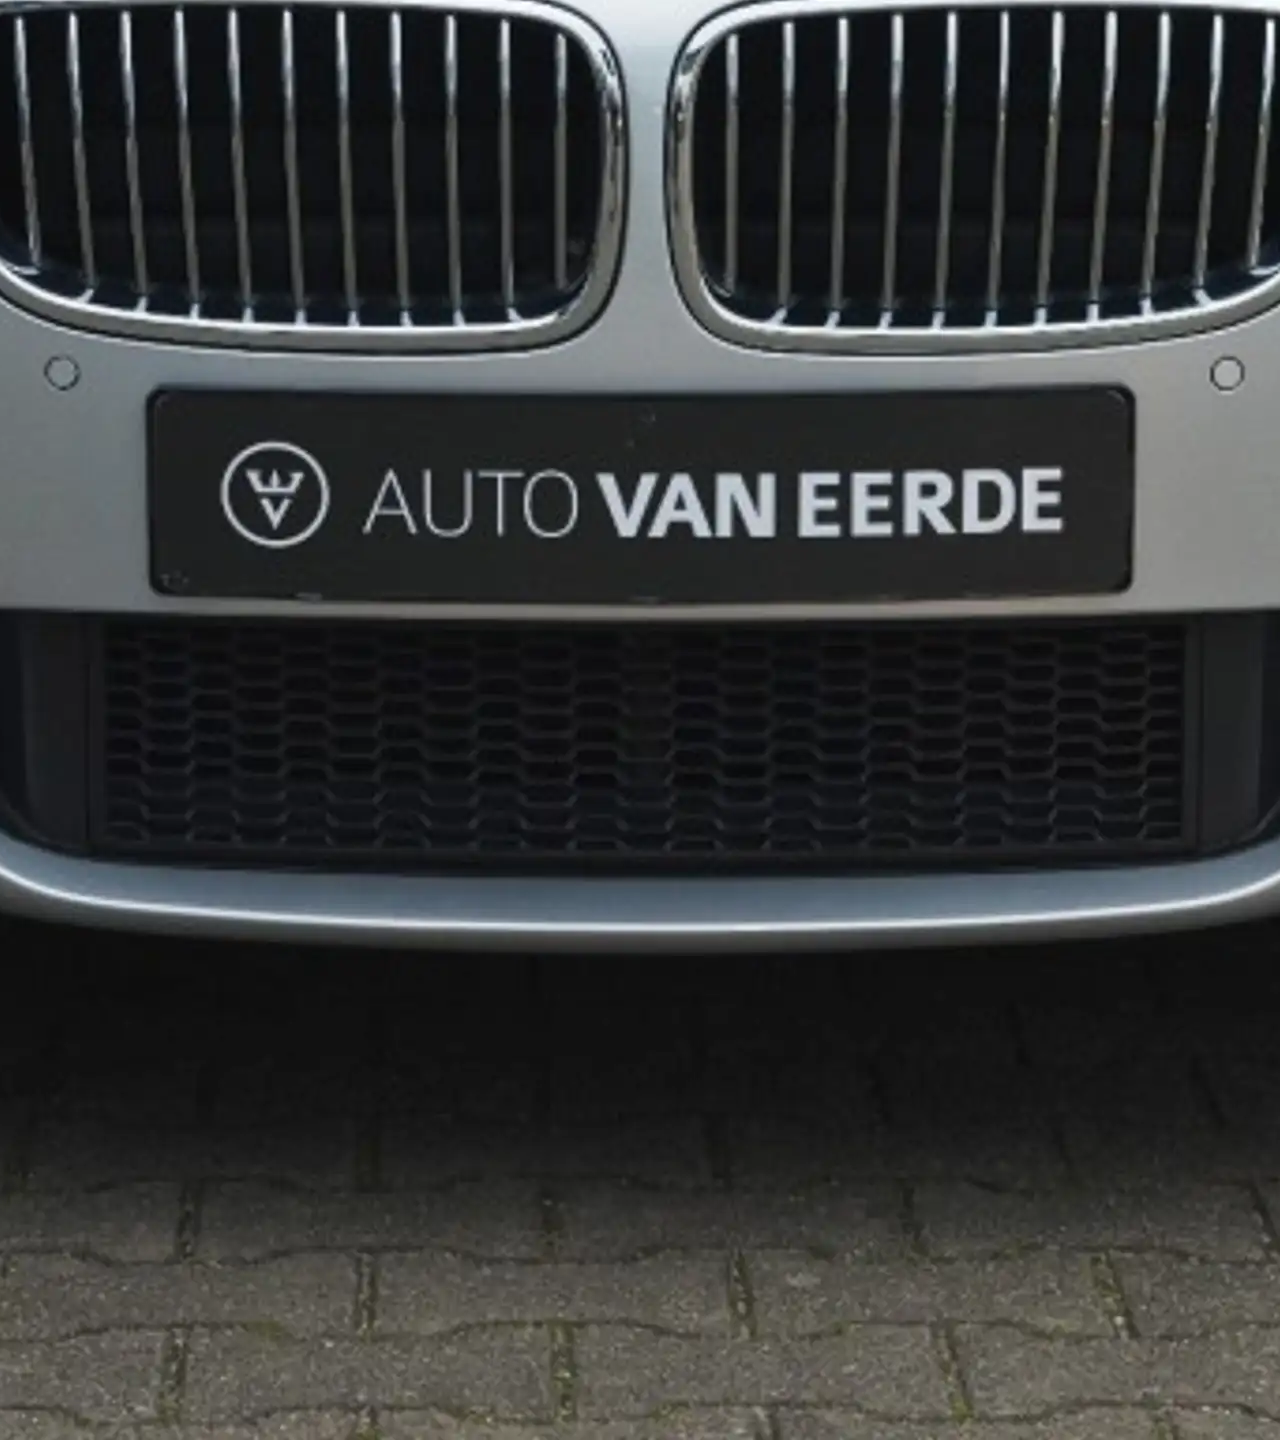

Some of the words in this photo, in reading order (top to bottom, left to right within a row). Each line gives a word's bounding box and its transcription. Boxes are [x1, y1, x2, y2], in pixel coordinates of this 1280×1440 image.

[362, 468, 579, 539] AUTO
[595, 471, 777, 539] VAN
[797, 466, 1064, 538] EERDE
